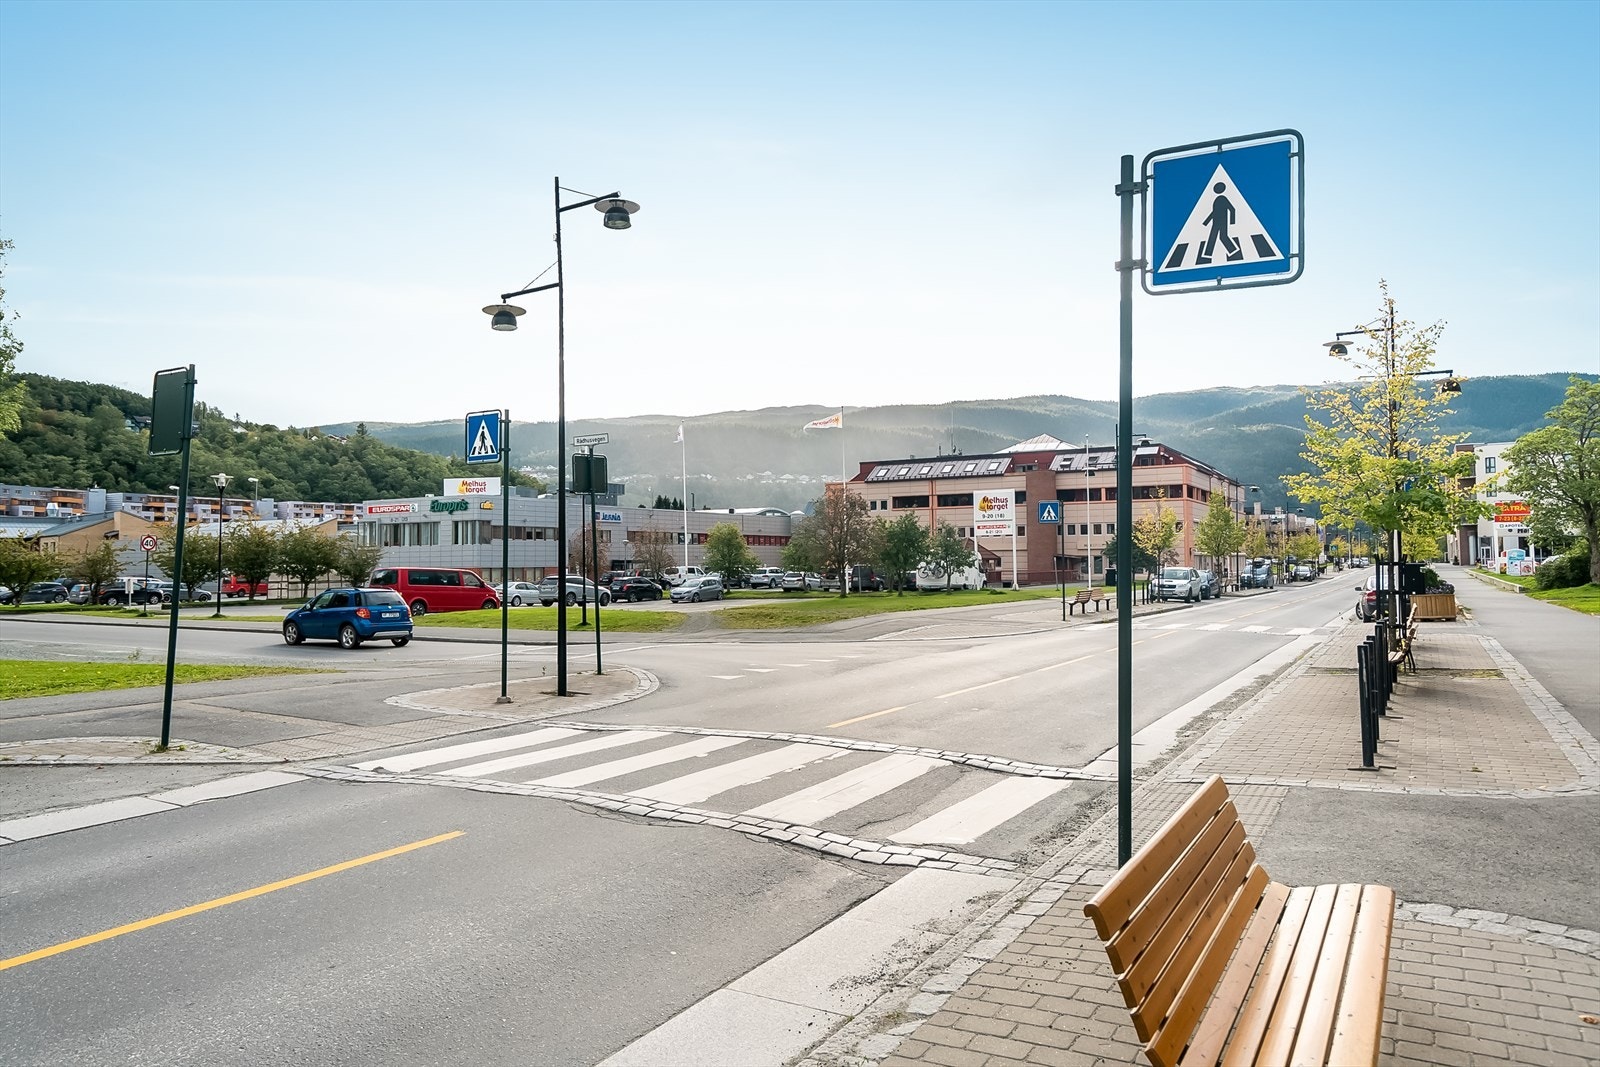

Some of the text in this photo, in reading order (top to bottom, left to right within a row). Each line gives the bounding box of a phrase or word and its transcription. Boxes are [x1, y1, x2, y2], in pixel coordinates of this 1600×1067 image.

[576, 436, 606, 444] Rådhusvegen
[465, 486, 487, 494] torget
[983, 496, 1009, 504] Melhus
[372, 505, 410, 513] EUROSPAR
[430, 499, 469, 515] Europris
[986, 503, 1008, 511] torget
[144, 539, 154, 547] 40
